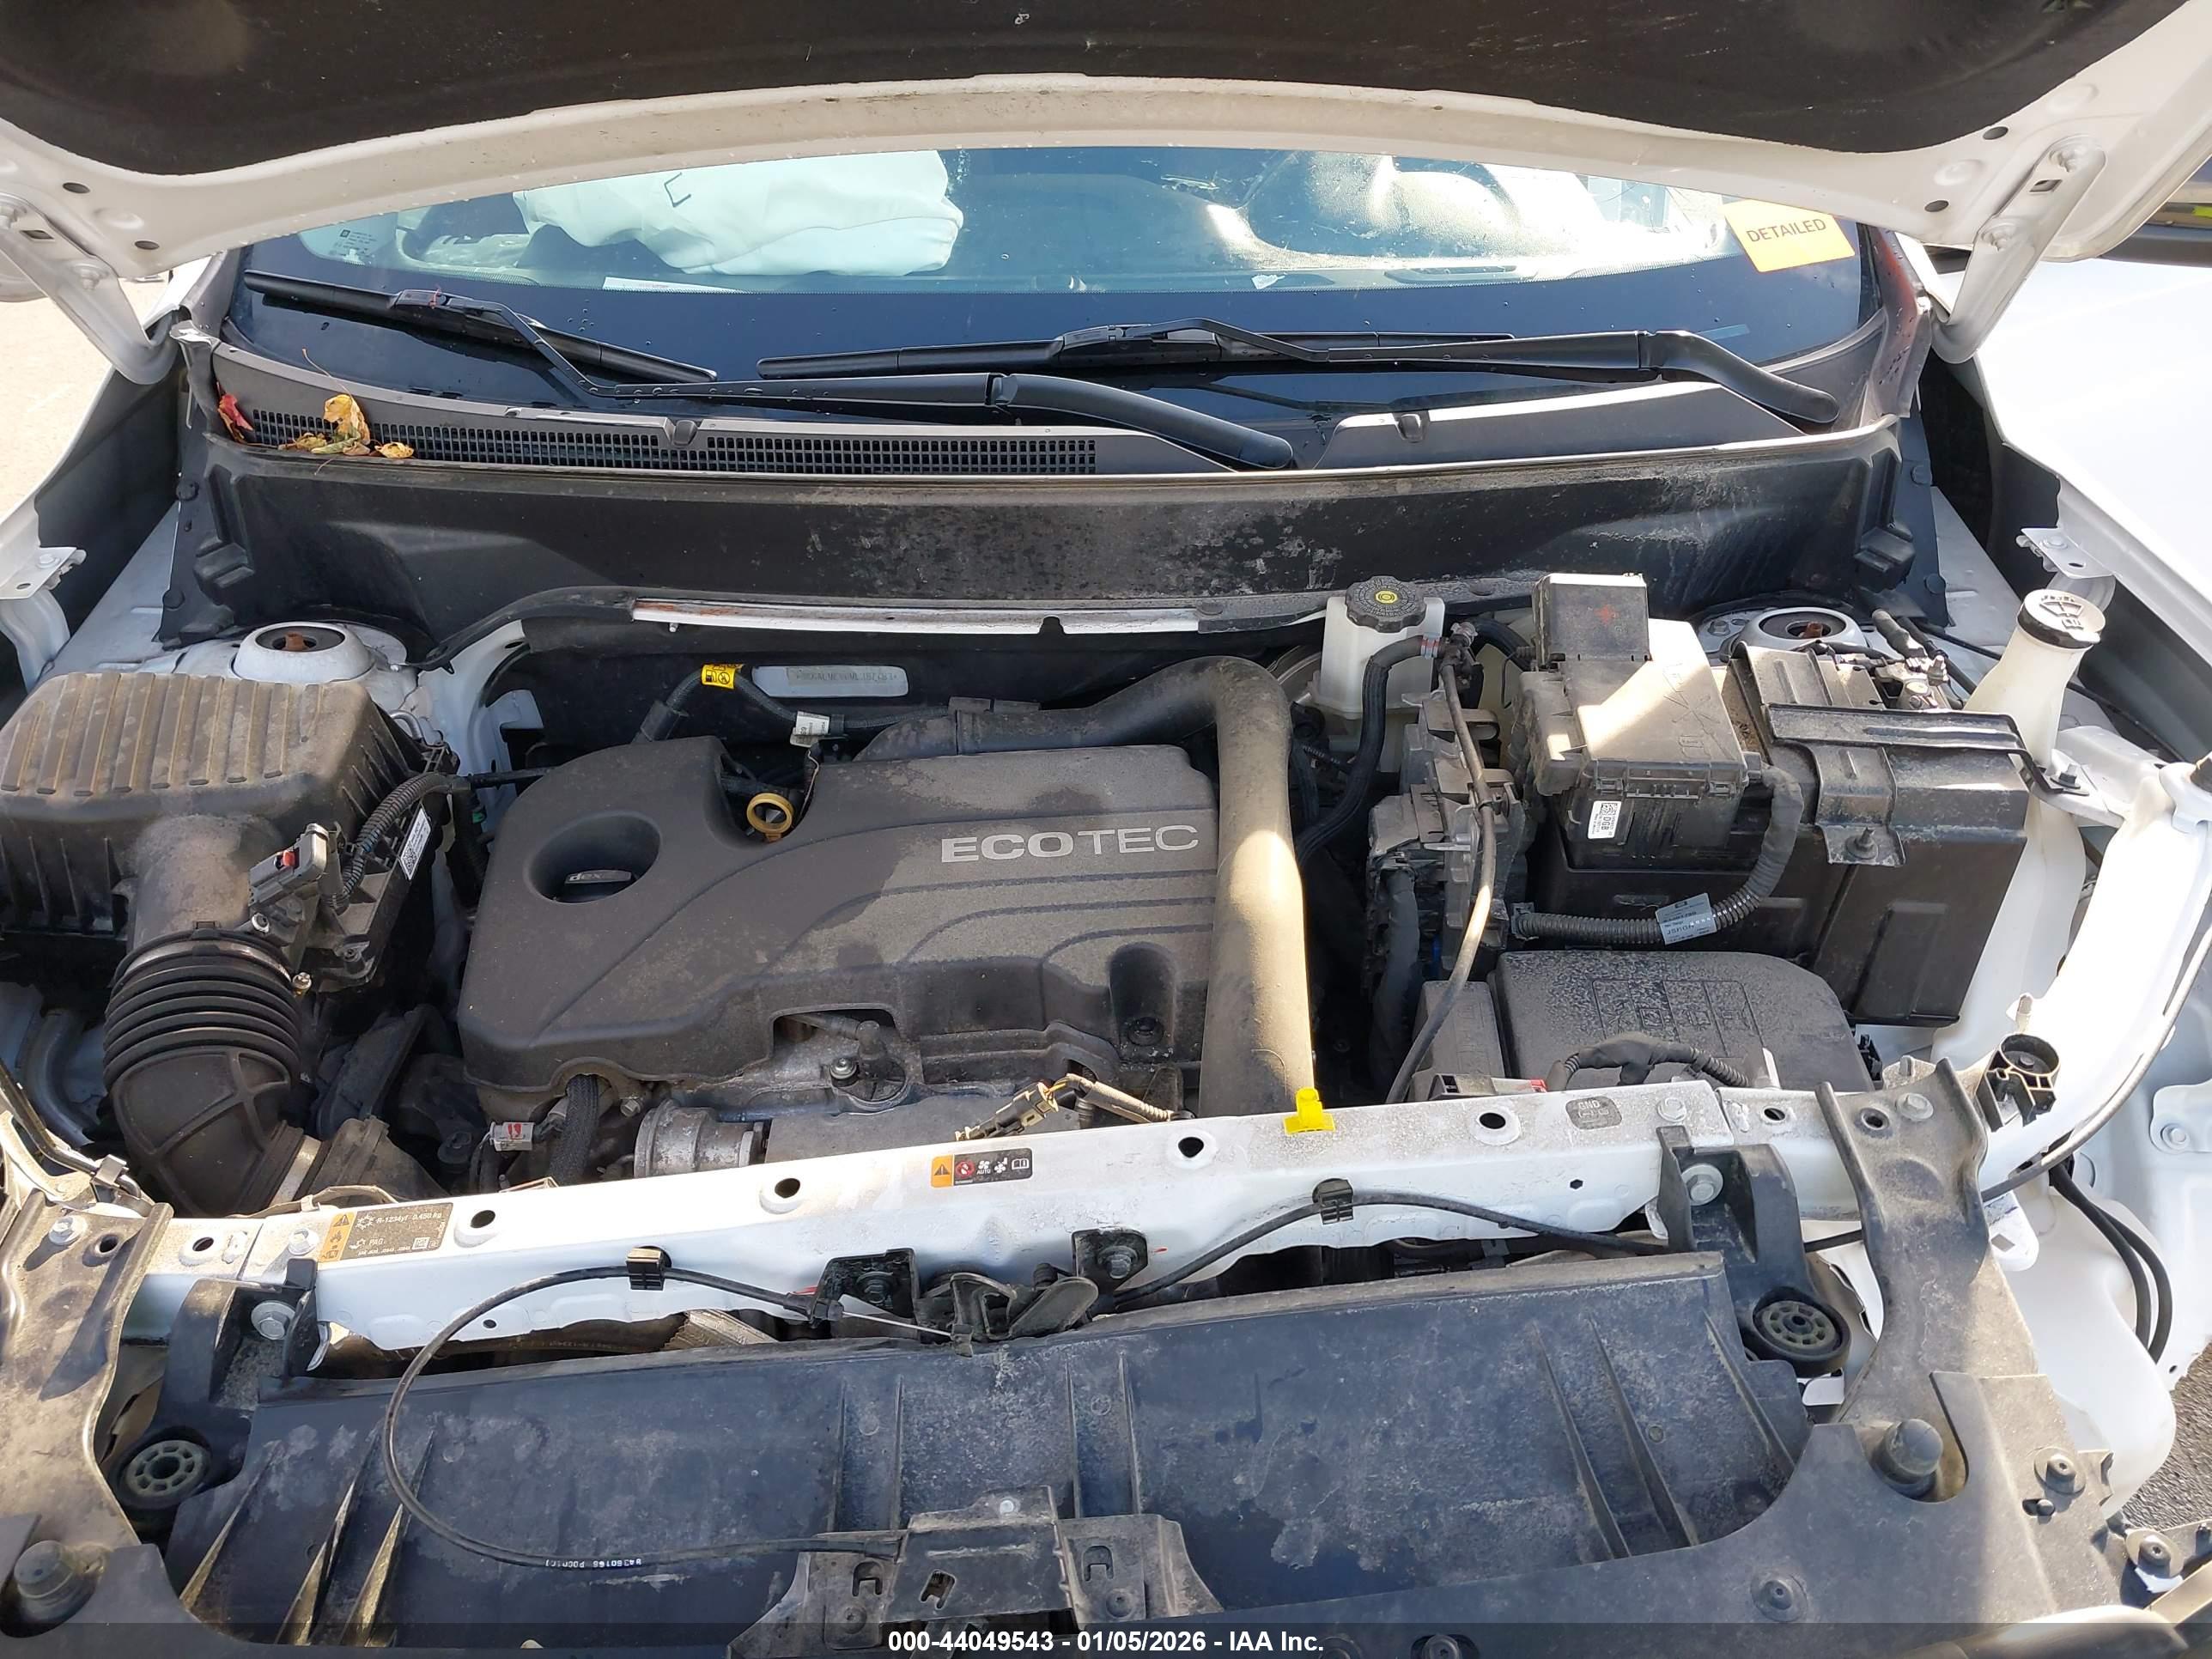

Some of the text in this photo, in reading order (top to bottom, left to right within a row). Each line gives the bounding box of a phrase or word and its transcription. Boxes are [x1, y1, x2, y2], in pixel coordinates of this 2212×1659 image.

[1746, 218, 1826, 242] DETAILED
[1601, 817, 1612, 830] DGB
[941, 824, 1199, 863] ECOTEC
[376, 1215, 408, 1224] R-1234yf
